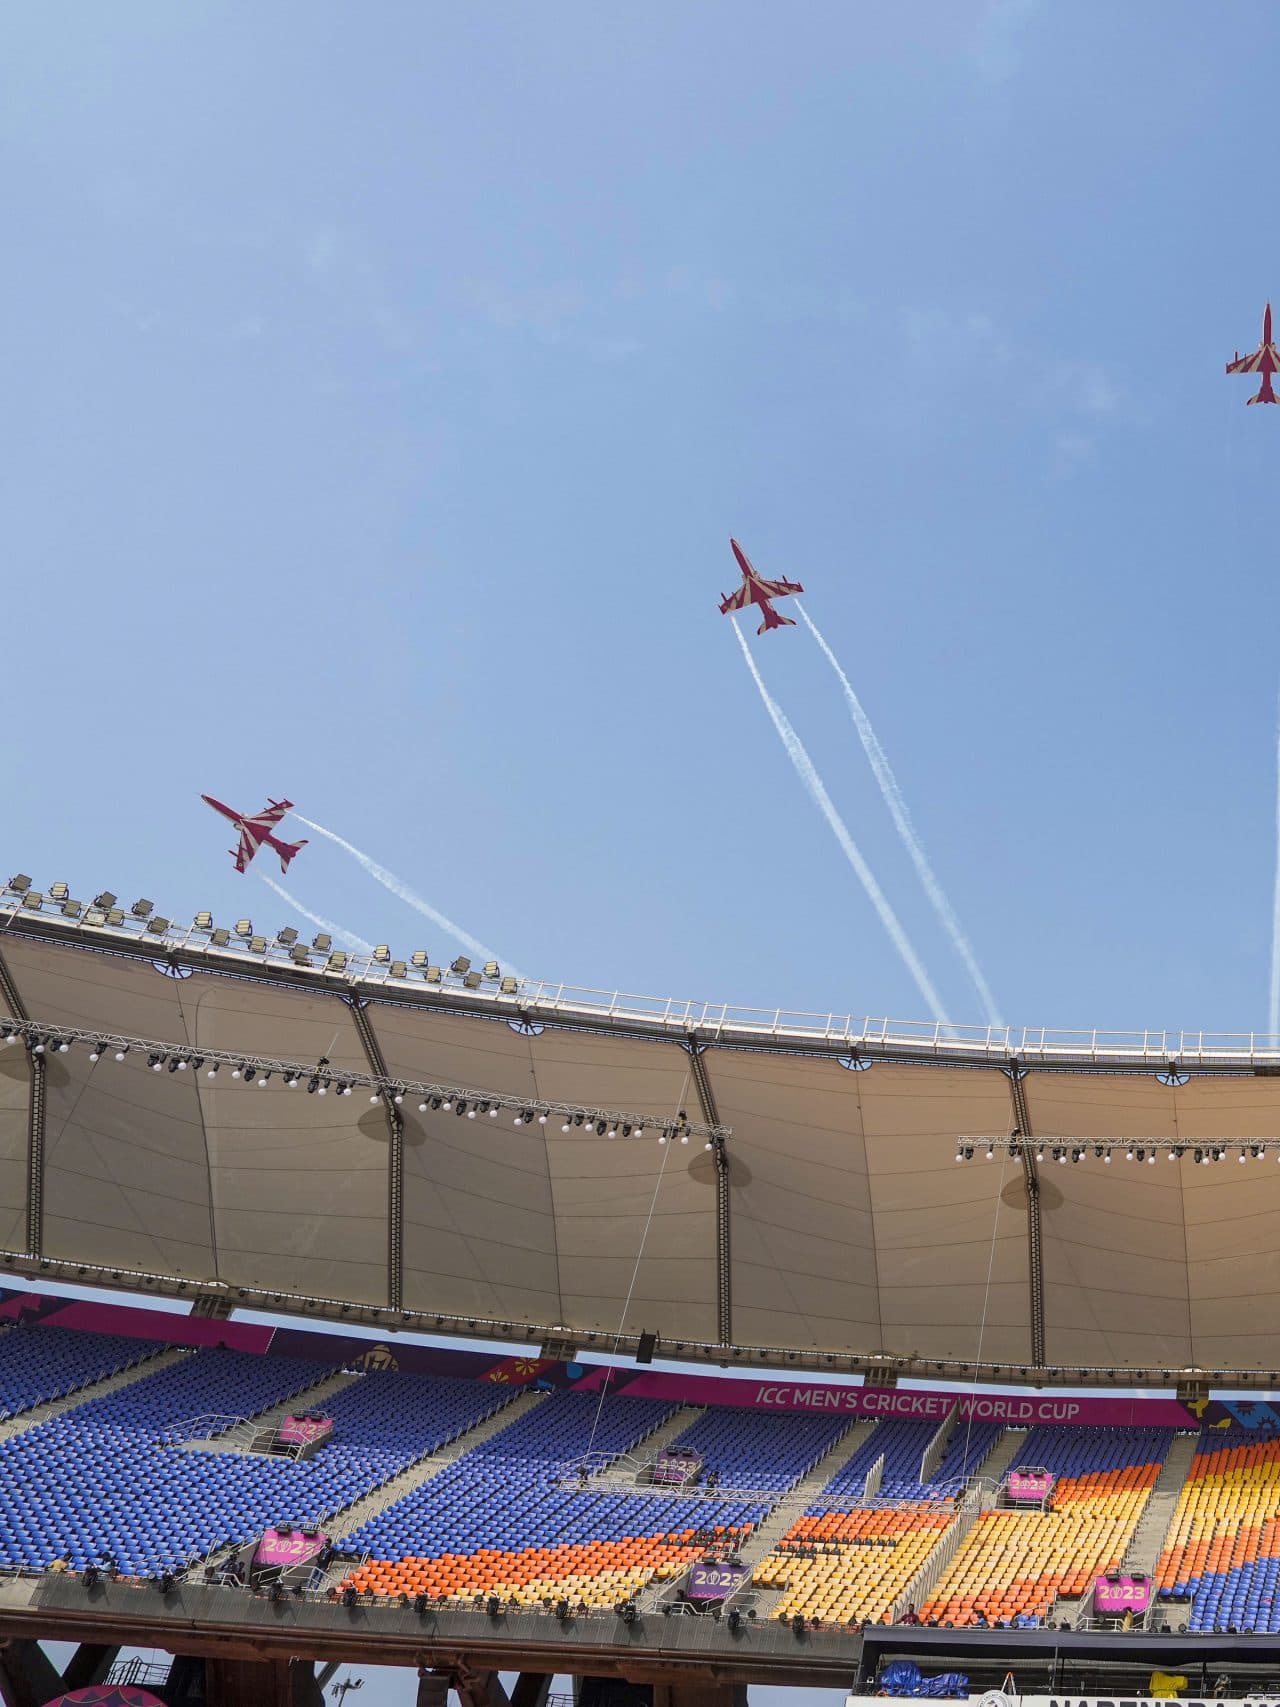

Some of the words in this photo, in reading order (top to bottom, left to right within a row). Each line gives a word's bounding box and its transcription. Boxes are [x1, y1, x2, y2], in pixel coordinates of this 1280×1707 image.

[756, 1386, 793, 1404] ICC
[793, 1389, 858, 1410] MEN'S
[863, 1393, 951, 1415] CRICKET
[957, 1399, 1034, 1419] WORLD
[1038, 1402, 1080, 1420] CUP
[1098, 1585, 1146, 1600] 2023
